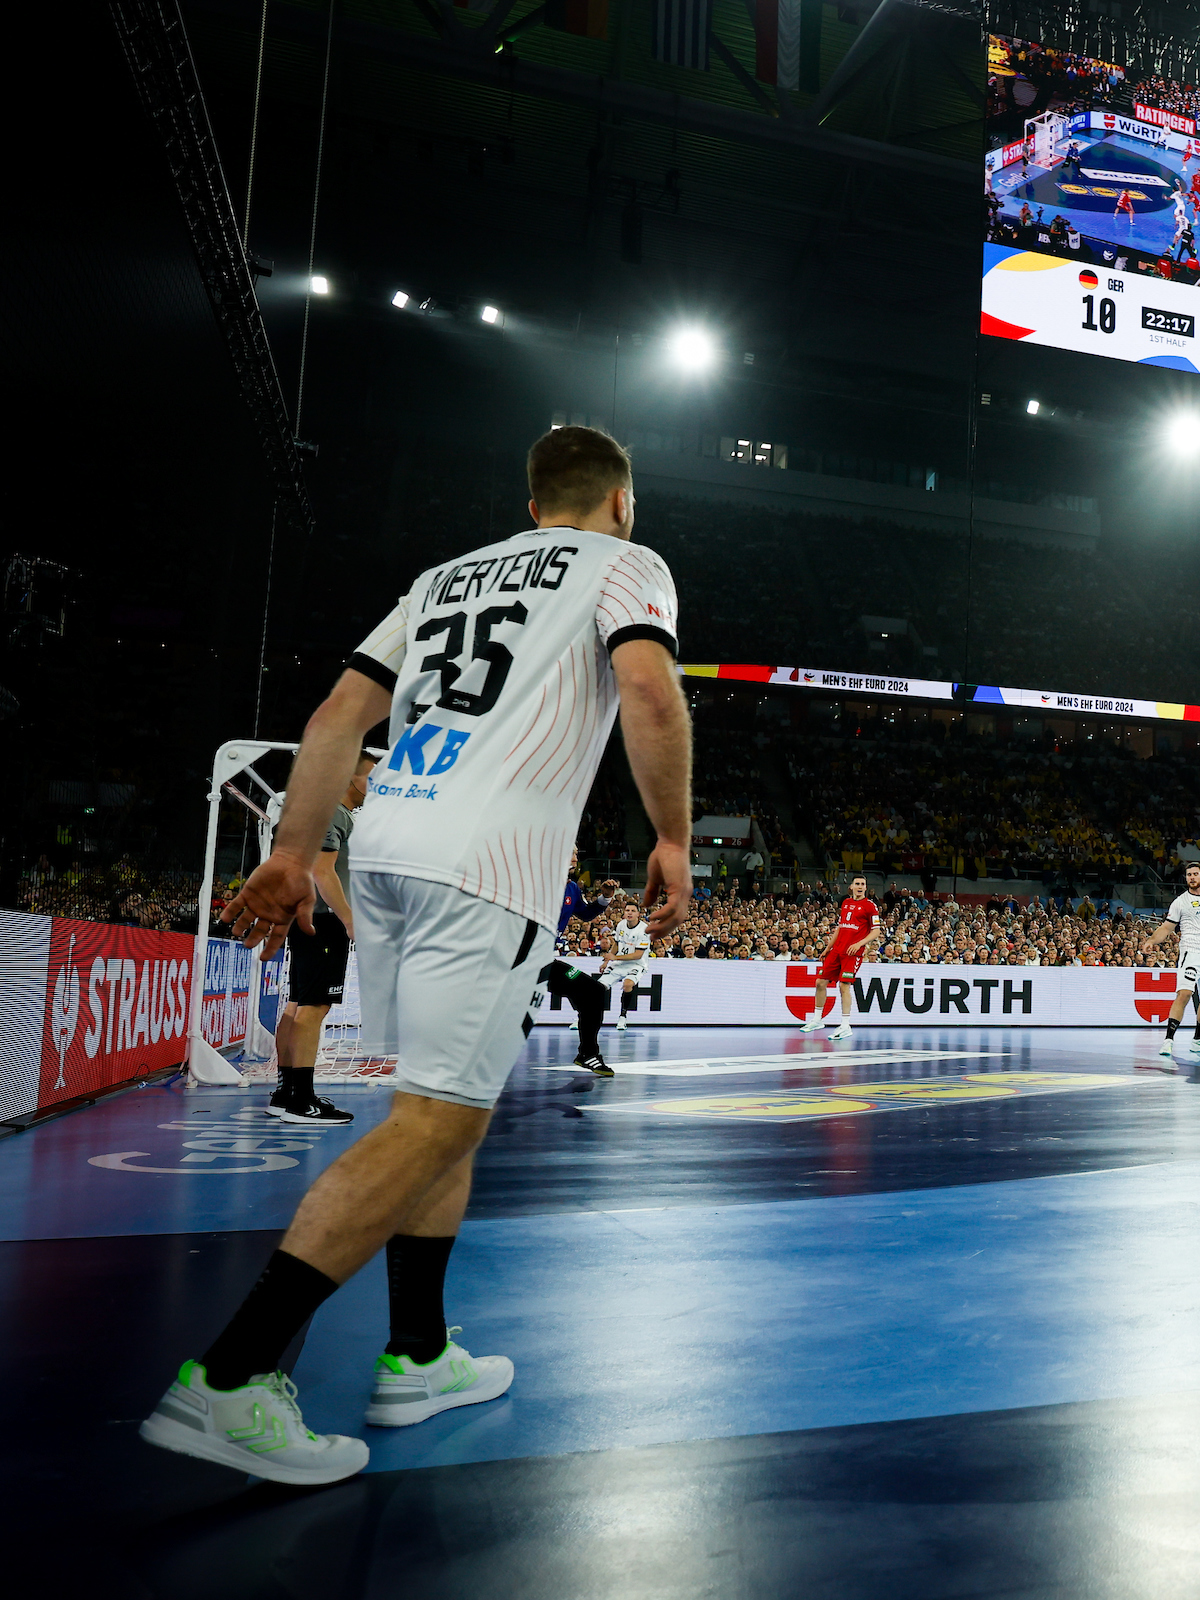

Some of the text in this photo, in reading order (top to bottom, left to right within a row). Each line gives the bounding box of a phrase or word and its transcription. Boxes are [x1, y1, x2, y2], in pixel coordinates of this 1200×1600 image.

[1136, 103, 1195, 135] RATINGEN
[1107, 278, 1124, 293] GER
[1082, 294, 1116, 334] 10
[1146, 312, 1191, 333] 22:17
[1150, 334, 1187, 348] 1ST HALF
[422, 546, 579, 613] MERTENS
[822, 674, 909, 693] MEN'S EHF EURO 2024
[1057, 696, 1134, 713] MEN'S EHF EURO 2024
[387, 723, 471, 776] KB
[404, 783, 438, 801] Bank
[846, 911, 852, 921] 8
[853, 977, 1033, 1015] WÜRTH
[84, 956, 189, 1060] STRAUSS
